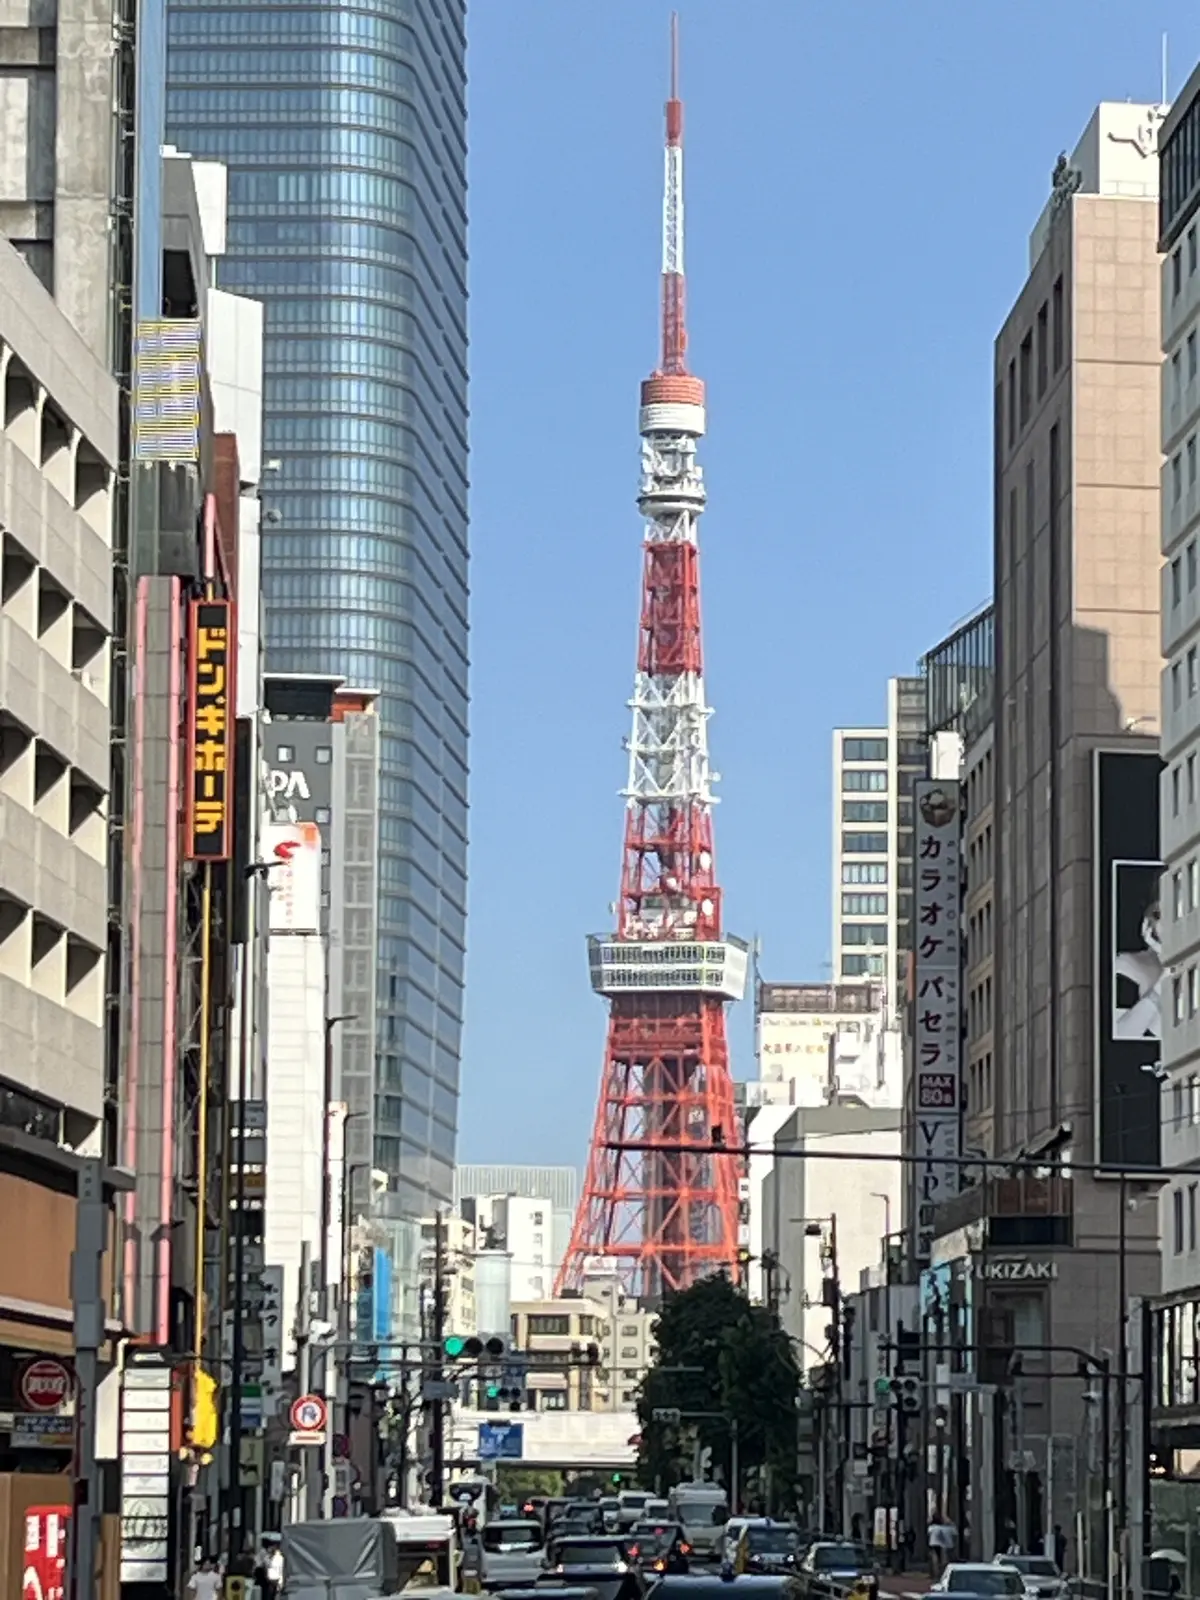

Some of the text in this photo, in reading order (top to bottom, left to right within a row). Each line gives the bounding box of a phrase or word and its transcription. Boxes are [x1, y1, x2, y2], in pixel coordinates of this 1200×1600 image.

[266, 769, 311, 799] PA
[919, 835, 944, 959] カラオケ
[921, 1076, 952, 1088] MAX
